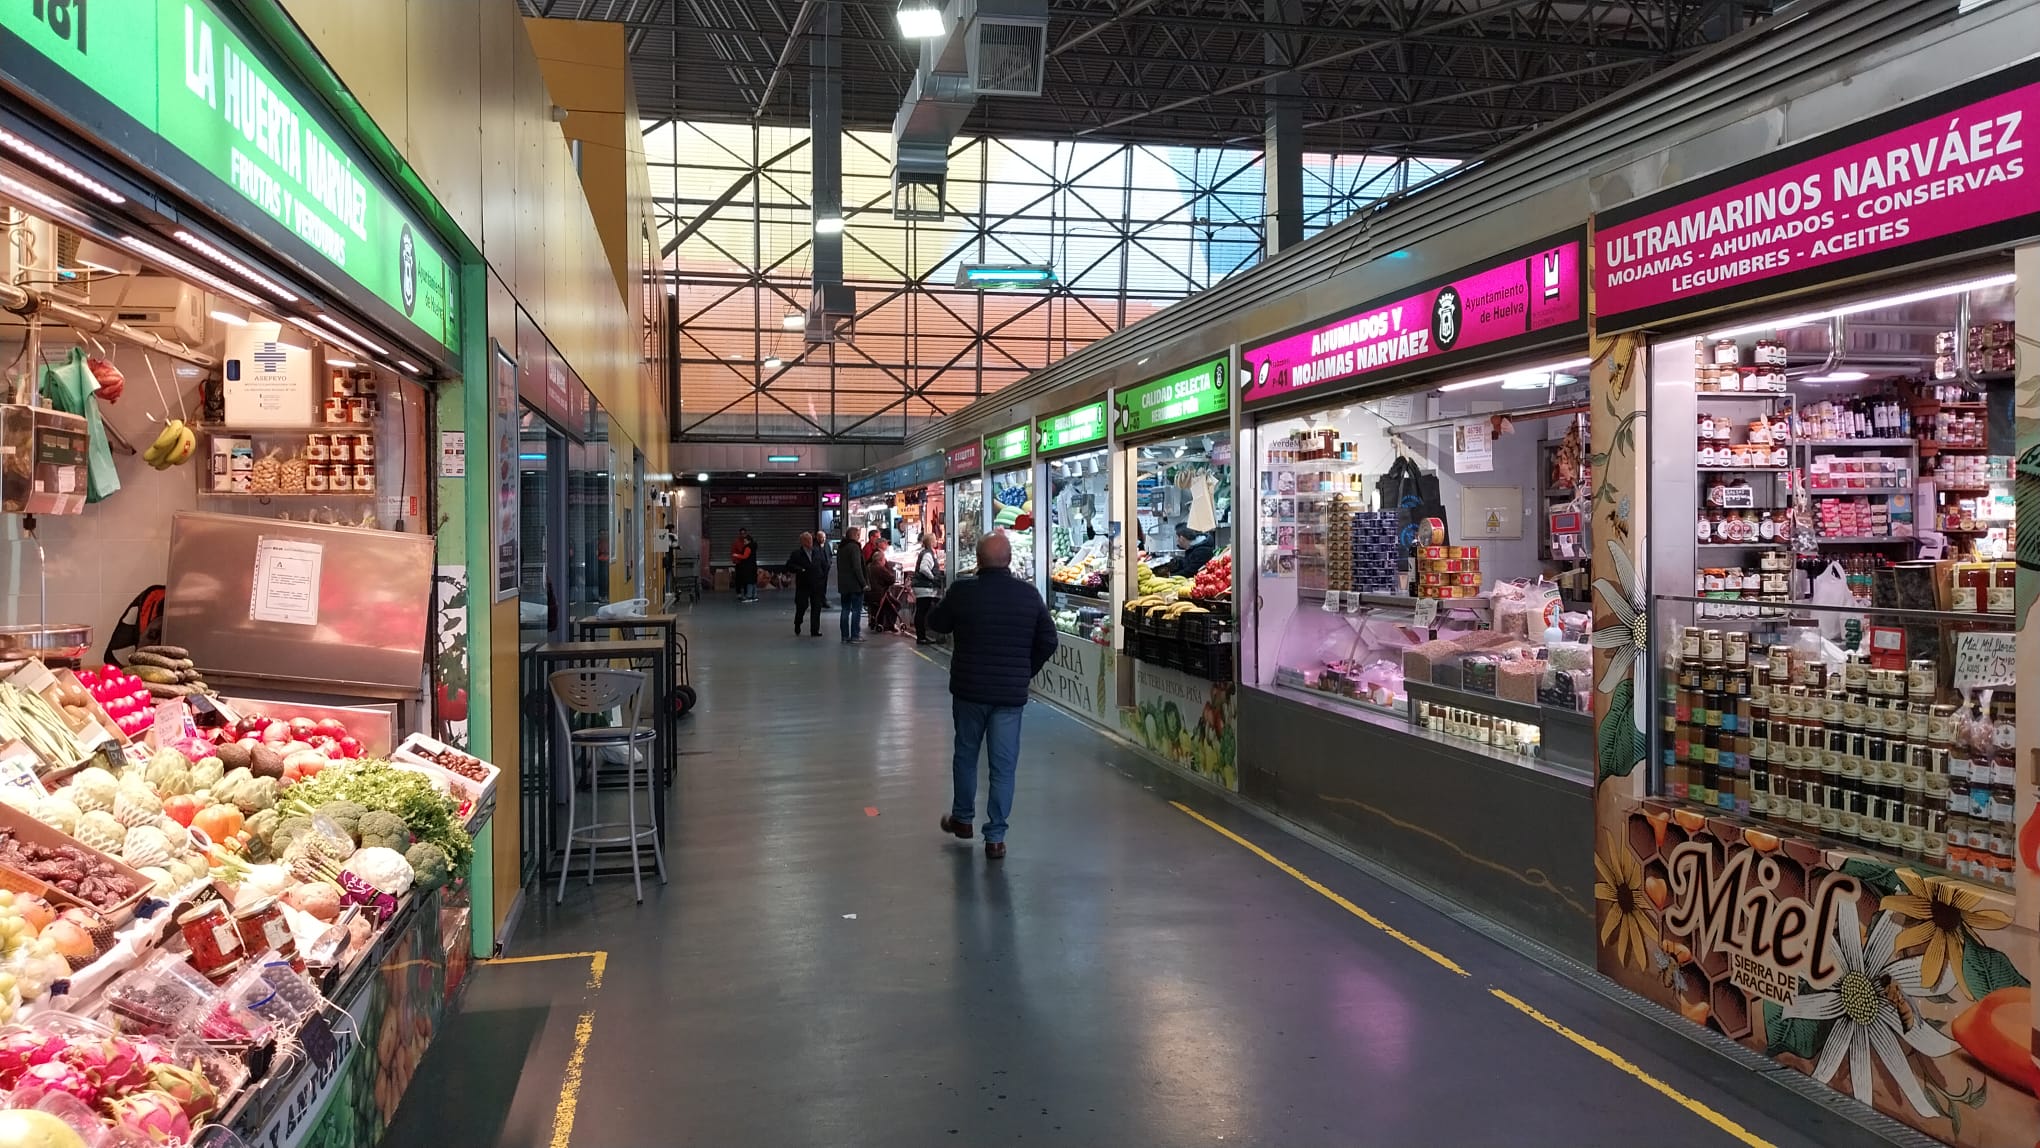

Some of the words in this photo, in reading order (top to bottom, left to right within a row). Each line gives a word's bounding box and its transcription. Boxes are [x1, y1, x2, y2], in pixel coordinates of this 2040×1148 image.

[185, 3, 216, 110] LA
[224, 43, 302, 184] HUERTA
[306, 128, 367, 242] NARVÁEZ
[231, 146, 281, 217] FRUTAS
[283, 189, 292, 225] Y
[294, 198, 346, 267] VERDURAS
[1606, 174, 1822, 267] ULTRAMARINOS
[1834, 111, 2023, 201] NARVÁEZ
[1608, 251, 1693, 287] MOJAMAS
[1710, 211, 1834, 259] AHUMADOS
[1857, 158, 2024, 219] CONSERVAS
[1672, 249, 1790, 293] LEGUMBRES
[1810, 218, 1910, 258] ACEITES
[1465, 284, 1524, 312] Ayuntamiento
[1480, 311, 1491, 323] de
[1494, 302, 1524, 320] Huelva
[1292, 351, 1353, 387] MOJAMAS
[1357, 329, 1429, 370] NARVÁEZ
[1311, 312, 1388, 356] AHUMADOS
[1391, 306, 1402, 331] Y
[1142, 385, 1173, 408] CALIDAD
[1175, 372, 1211, 399] SELECTA
[1059, 674, 1092, 713] PIÑA
[1670, 847, 1858, 980] Miel
[1735, 954, 1774, 982] SIERRA
[1778, 971, 1796, 990] DE
[1735, 970, 1793, 1006] ARACENA
